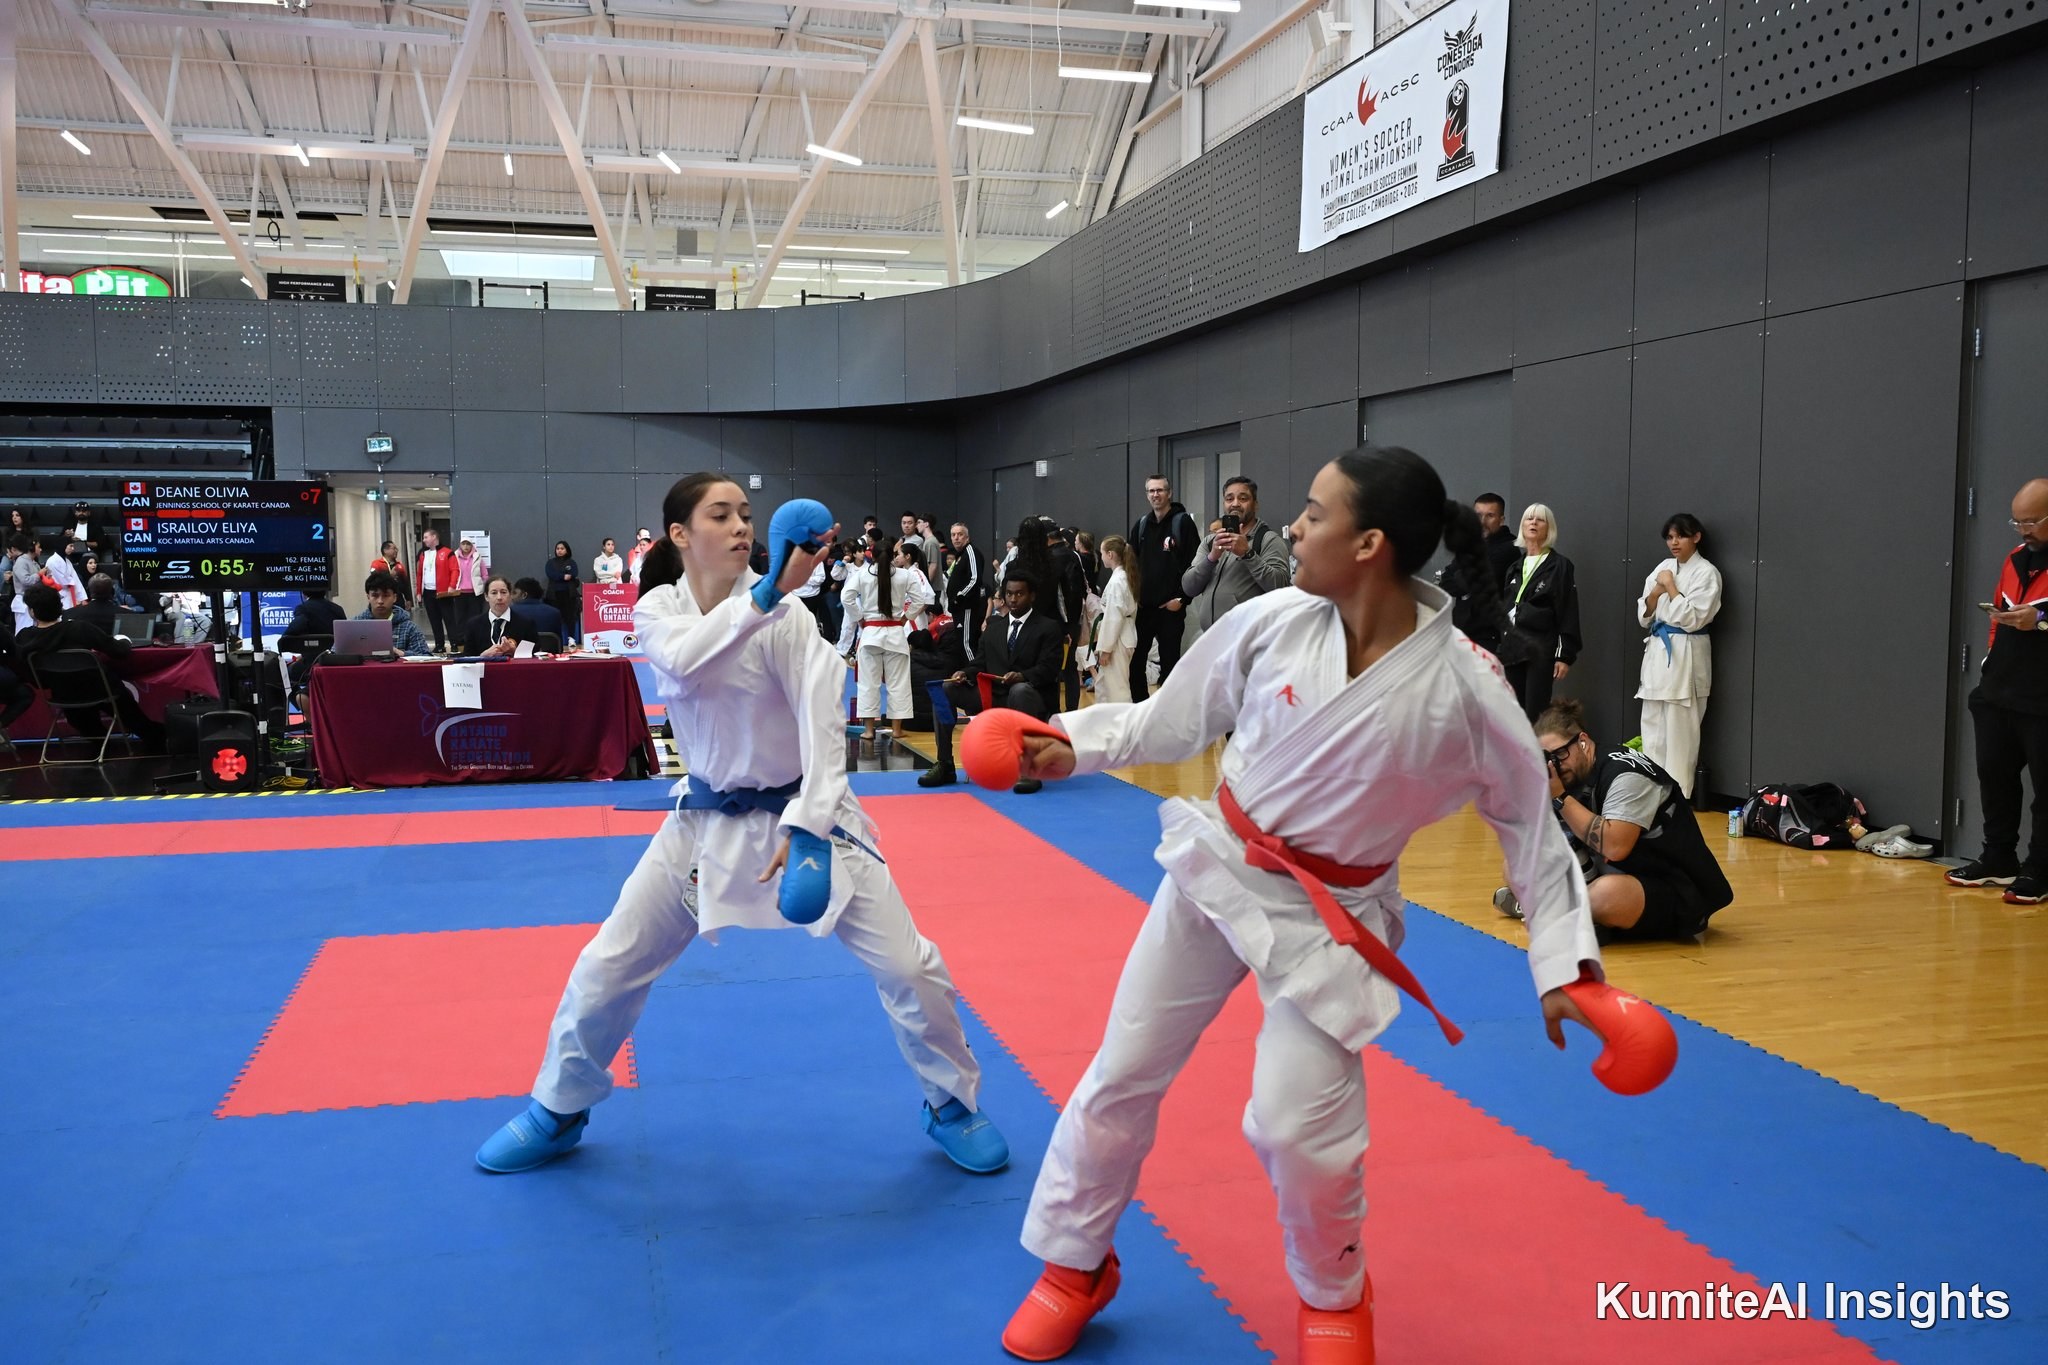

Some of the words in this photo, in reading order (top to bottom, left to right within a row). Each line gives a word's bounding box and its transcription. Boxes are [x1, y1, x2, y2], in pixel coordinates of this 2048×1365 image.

[1437, 33, 1482, 73] CONESTOGA
[1444, 53, 1474, 80] CONDORS
[1321, 111, 1354, 136] CCAA
[1380, 73, 1420, 103] ACSC
[1330, 139, 1369, 176] WOMEN'S
[1373, 117, 1412, 153] SOCCER
[1320, 169, 1354, 199] NATIONAL
[1358, 135, 1422, 180] CHAMPIONSHIP
[1373, 179, 1379, 193] DE
[1379, 171, 1397, 190] SOCCER
[1397, 162, 1418, 181] FEMININ
[1346, 203, 1367, 222] COLLEGE
[1370, 189, 1399, 212] CAMBRIDGE
[86, 269, 149, 296] Pit
[122, 497, 150, 507] CAN
[155, 486, 201, 498] DEANE
[204, 486, 250, 498] OLIVIA
[124, 532, 152, 543] CAN
[157, 522, 218, 534] ISRAILOV
[222, 522, 258, 534] ELIYA
[312, 523, 324, 540] 2
[145, 573, 151, 581] 2
[264, 610, 294, 618] KARATE
[264, 617, 294, 625] ONTARI
[450, 725, 508, 737] ONTARIO
[450, 738, 501, 750] KARATE
[451, 751, 531, 763] FEDERATION
